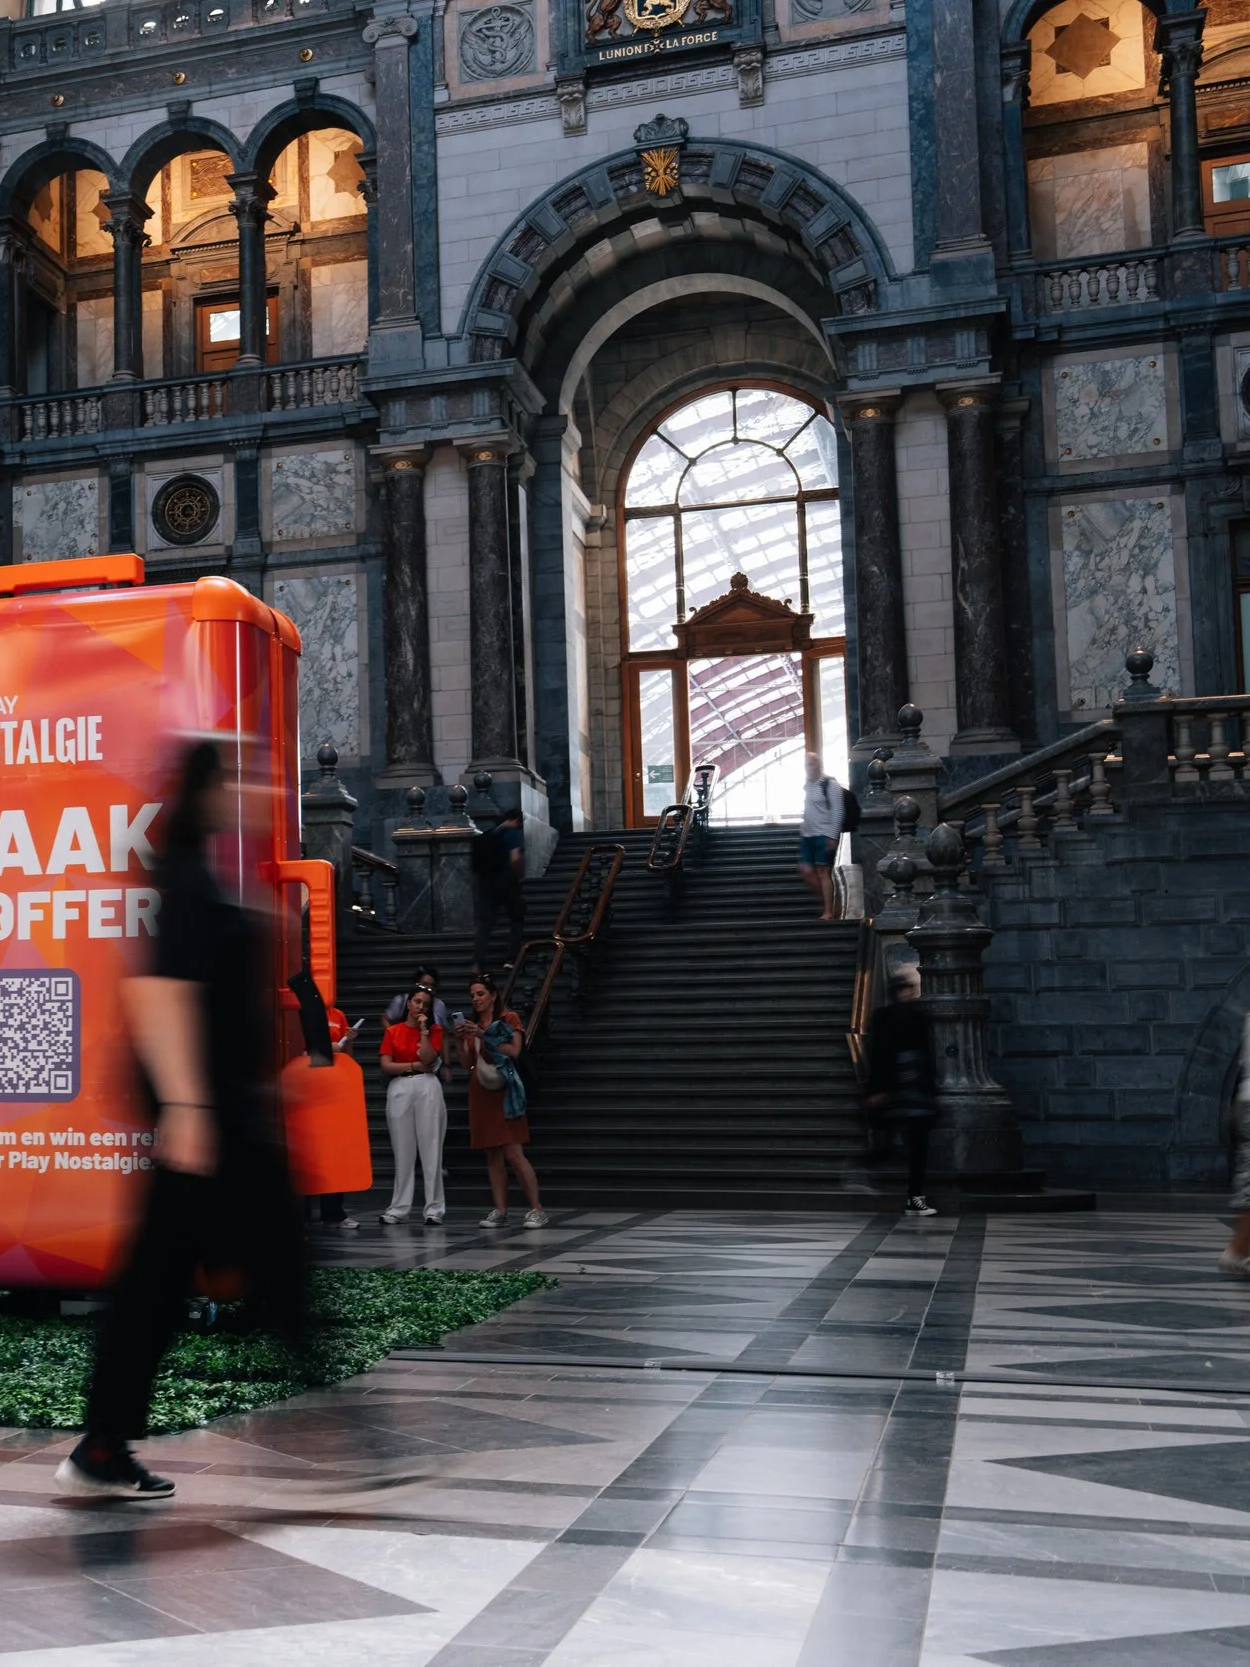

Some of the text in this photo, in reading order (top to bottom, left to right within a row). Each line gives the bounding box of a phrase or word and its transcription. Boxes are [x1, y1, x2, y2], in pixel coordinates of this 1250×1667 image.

[666, 39, 679, 49] LA
[681, 31, 718, 46] FORCE
[21, 1131, 45, 1146] en
[49, 1127, 85, 1146] win
[89, 1132, 127, 1147] een
[8, 1151, 50, 1173] Play
